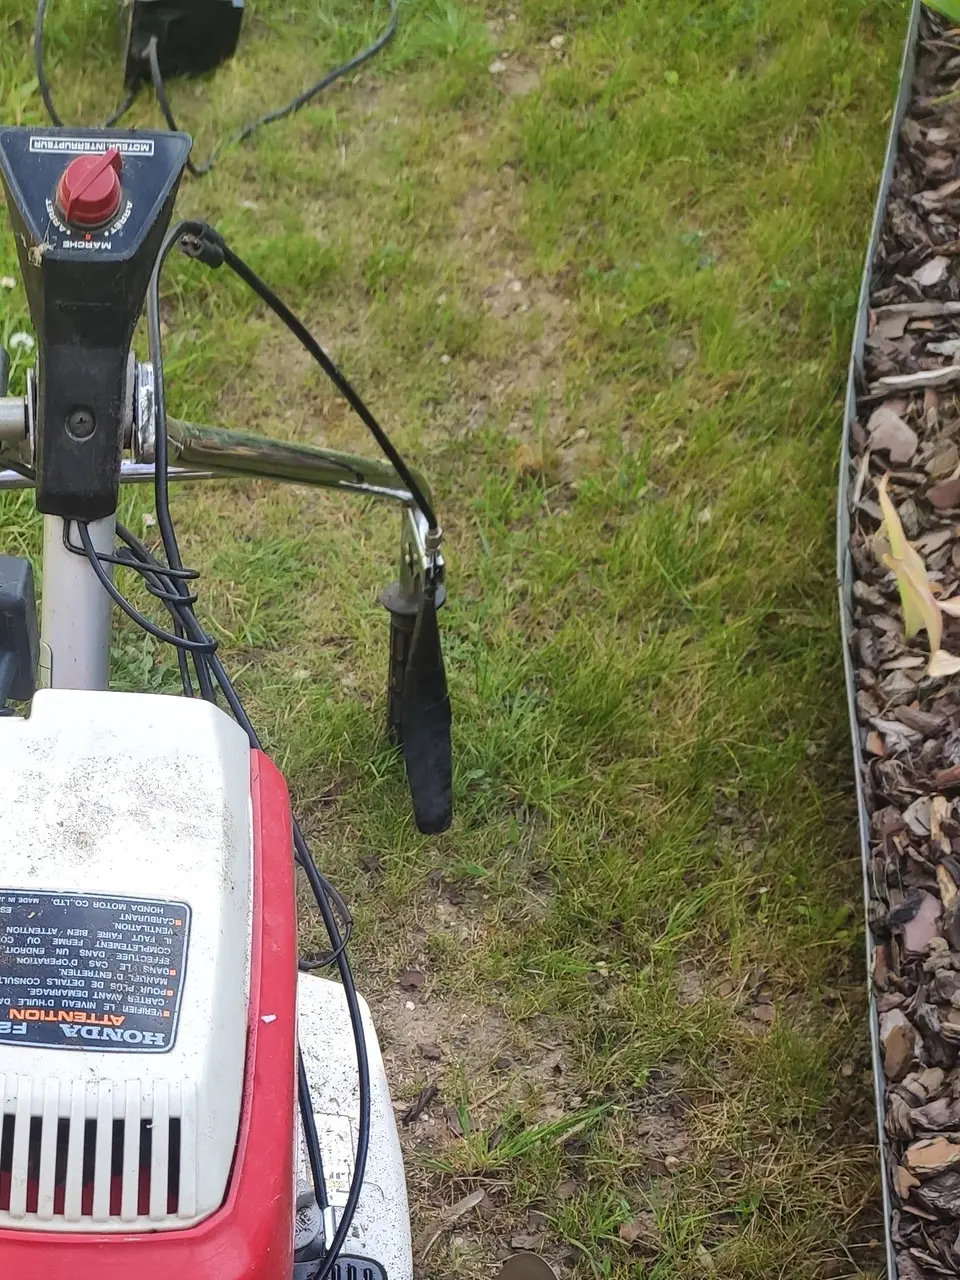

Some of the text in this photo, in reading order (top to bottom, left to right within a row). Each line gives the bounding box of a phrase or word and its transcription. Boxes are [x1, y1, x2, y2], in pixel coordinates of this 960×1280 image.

[45, 198, 67, 233] ARRET
[110, 200, 132, 234] ARRET
[63, 241, 111, 249] MARCHE
[93, 900, 126, 910] MOTOR
[130, 903, 164, 913] HONDA
[119, 913, 175, 925] CARBURANT
[6, 926, 58, 935] ATTENTION
[67, 929, 88, 937] BIEN
[112, 922, 173, 935] VENTILATION.
[97, 930, 123, 939] FAIRE
[131, 933, 155, 943] FAUT
[27, 937, 40, 945] OU
[52, 938, 83, 946] FERME
[55, 948, 69, 956] UN
[95, 941, 171, 954] COMPLETEMENT
[79, 949, 105, 958] DANS
[116, 953, 170, 965] EFFECTUEE
[16, 957, 170, 975] DANS LE CAS D'OPERATION
[46, 978, 84, 988] DETAILS
[129, 974, 168, 985] MANUEL
[91, 981, 104, 989] DE
[110, 982, 134, 992] PLUS
[140, 986, 167, 995] POUR
[18, 998, 54, 1006] D'HUILE
[28, 988, 165, 1006] CARTER AVANT DEMARRAGE.
[62, 999, 96, 1009] NIVEAU
[103, 1003, 115, 1011] LE
[122, 1005, 162, 1017] VERIFIER
[8, 1009, 125, 1026] ATTENTION
[59, 1024, 165, 1045] HONDA
